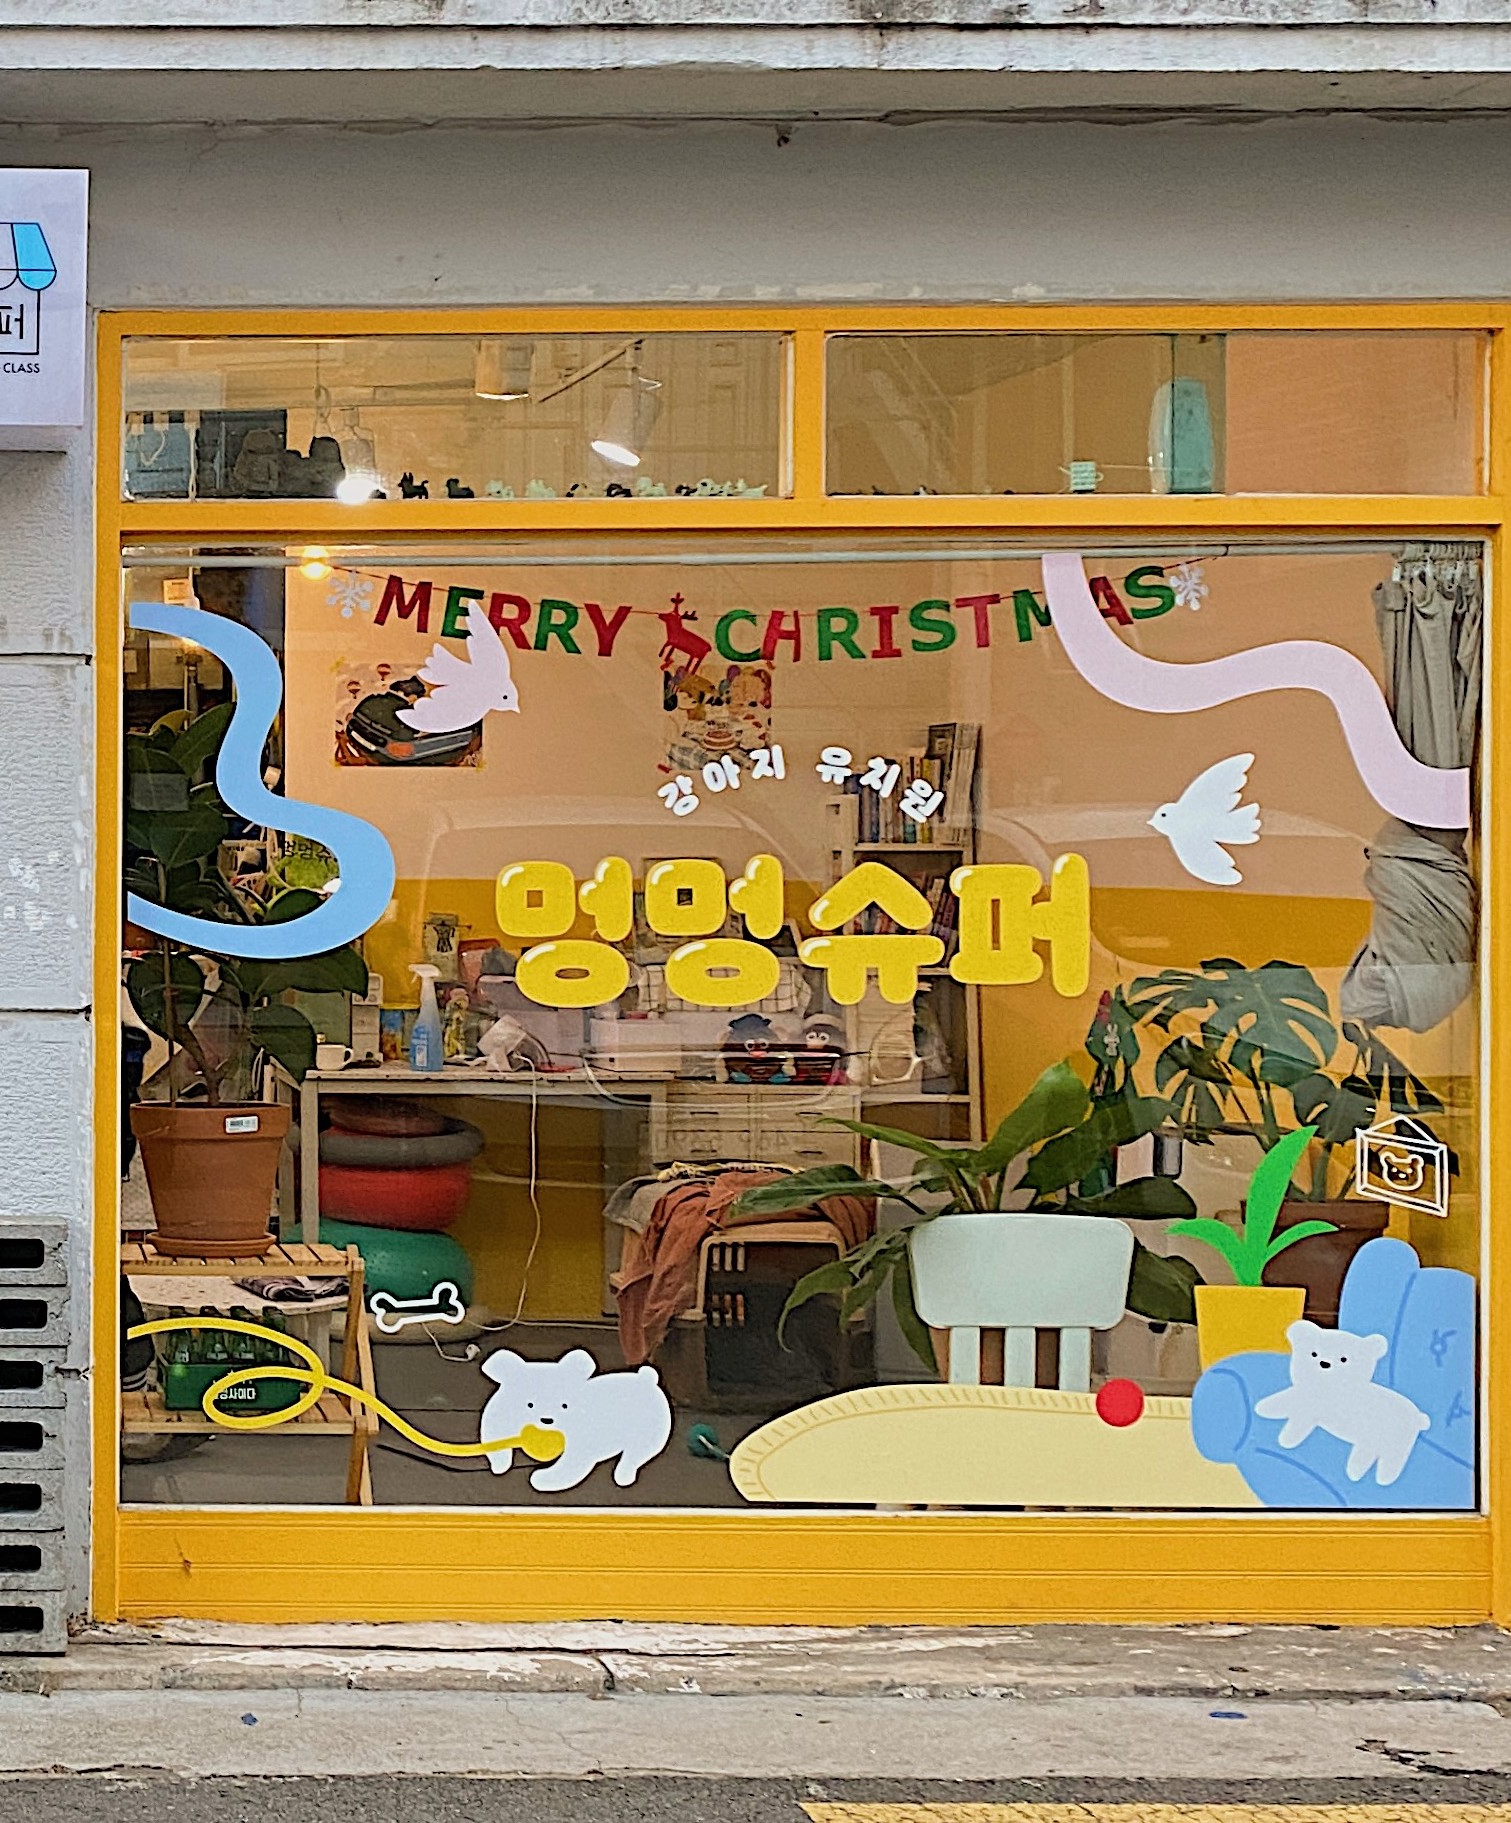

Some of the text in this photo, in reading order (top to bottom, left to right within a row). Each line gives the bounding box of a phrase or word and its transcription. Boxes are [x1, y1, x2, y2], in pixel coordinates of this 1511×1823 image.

[2, 363, 40, 374] CLASS
[374, 565, 1176, 662] MERRY CHRISTMAS
[657, 744, 945, 823] 강아지 유치원
[494, 852, 1091, 1008] 멍멍슈퍼
